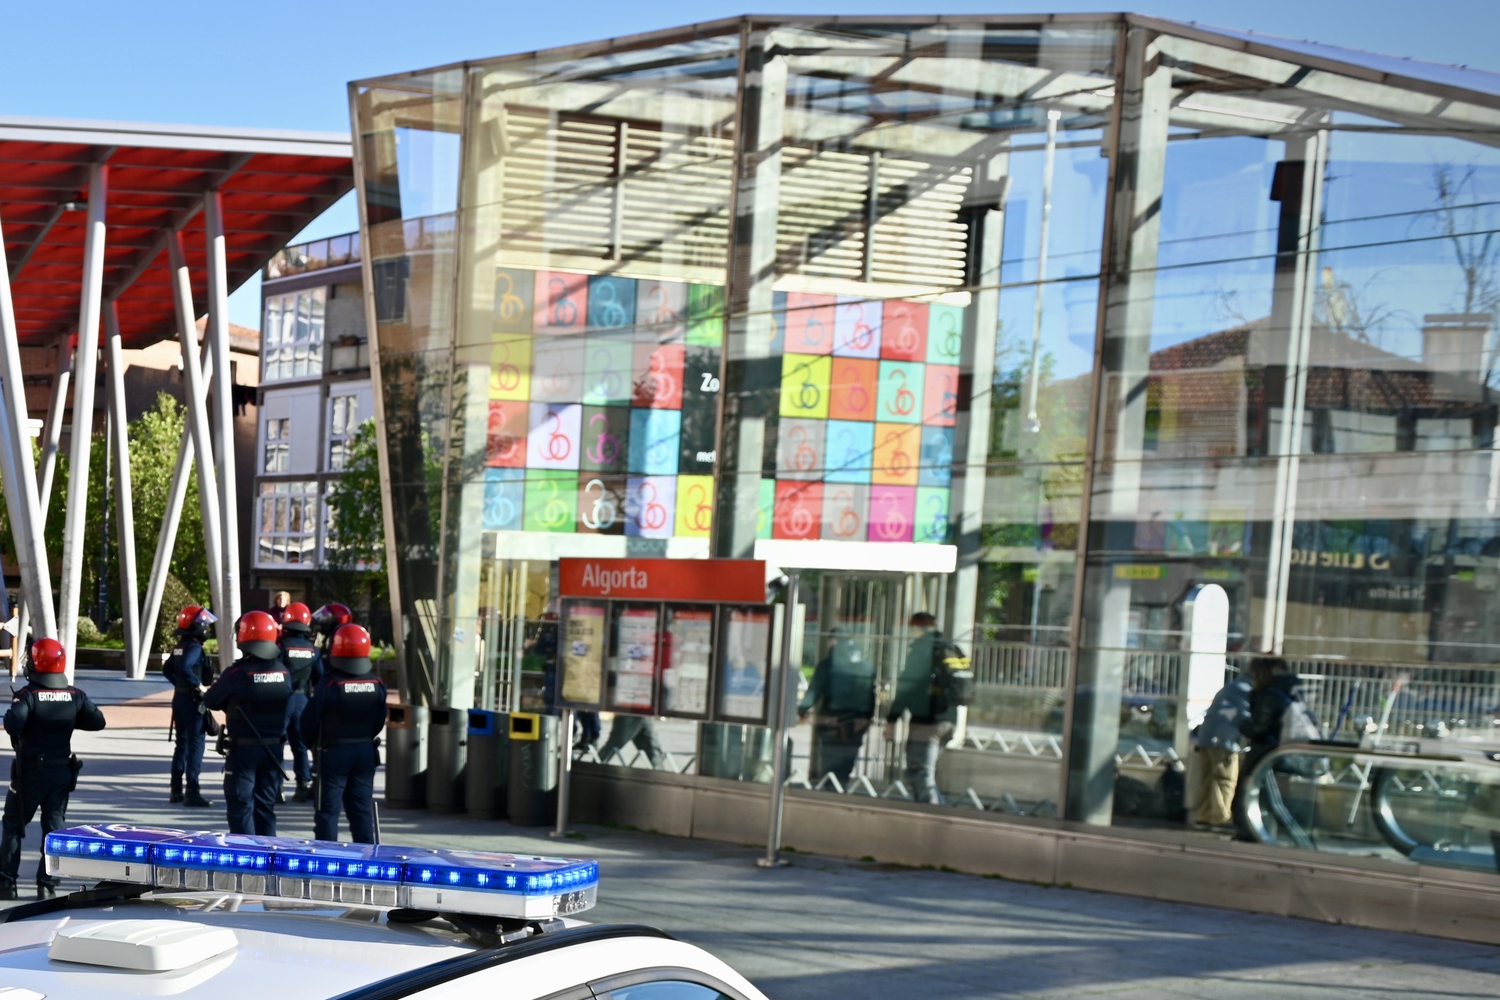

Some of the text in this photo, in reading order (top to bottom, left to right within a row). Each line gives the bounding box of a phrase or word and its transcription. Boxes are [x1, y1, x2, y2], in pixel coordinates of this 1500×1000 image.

[581, 563, 648, 595] Algorta
[253, 672, 285, 683] ERTZAINTZA
[38, 691, 72, 702] ERTZAINTZA
